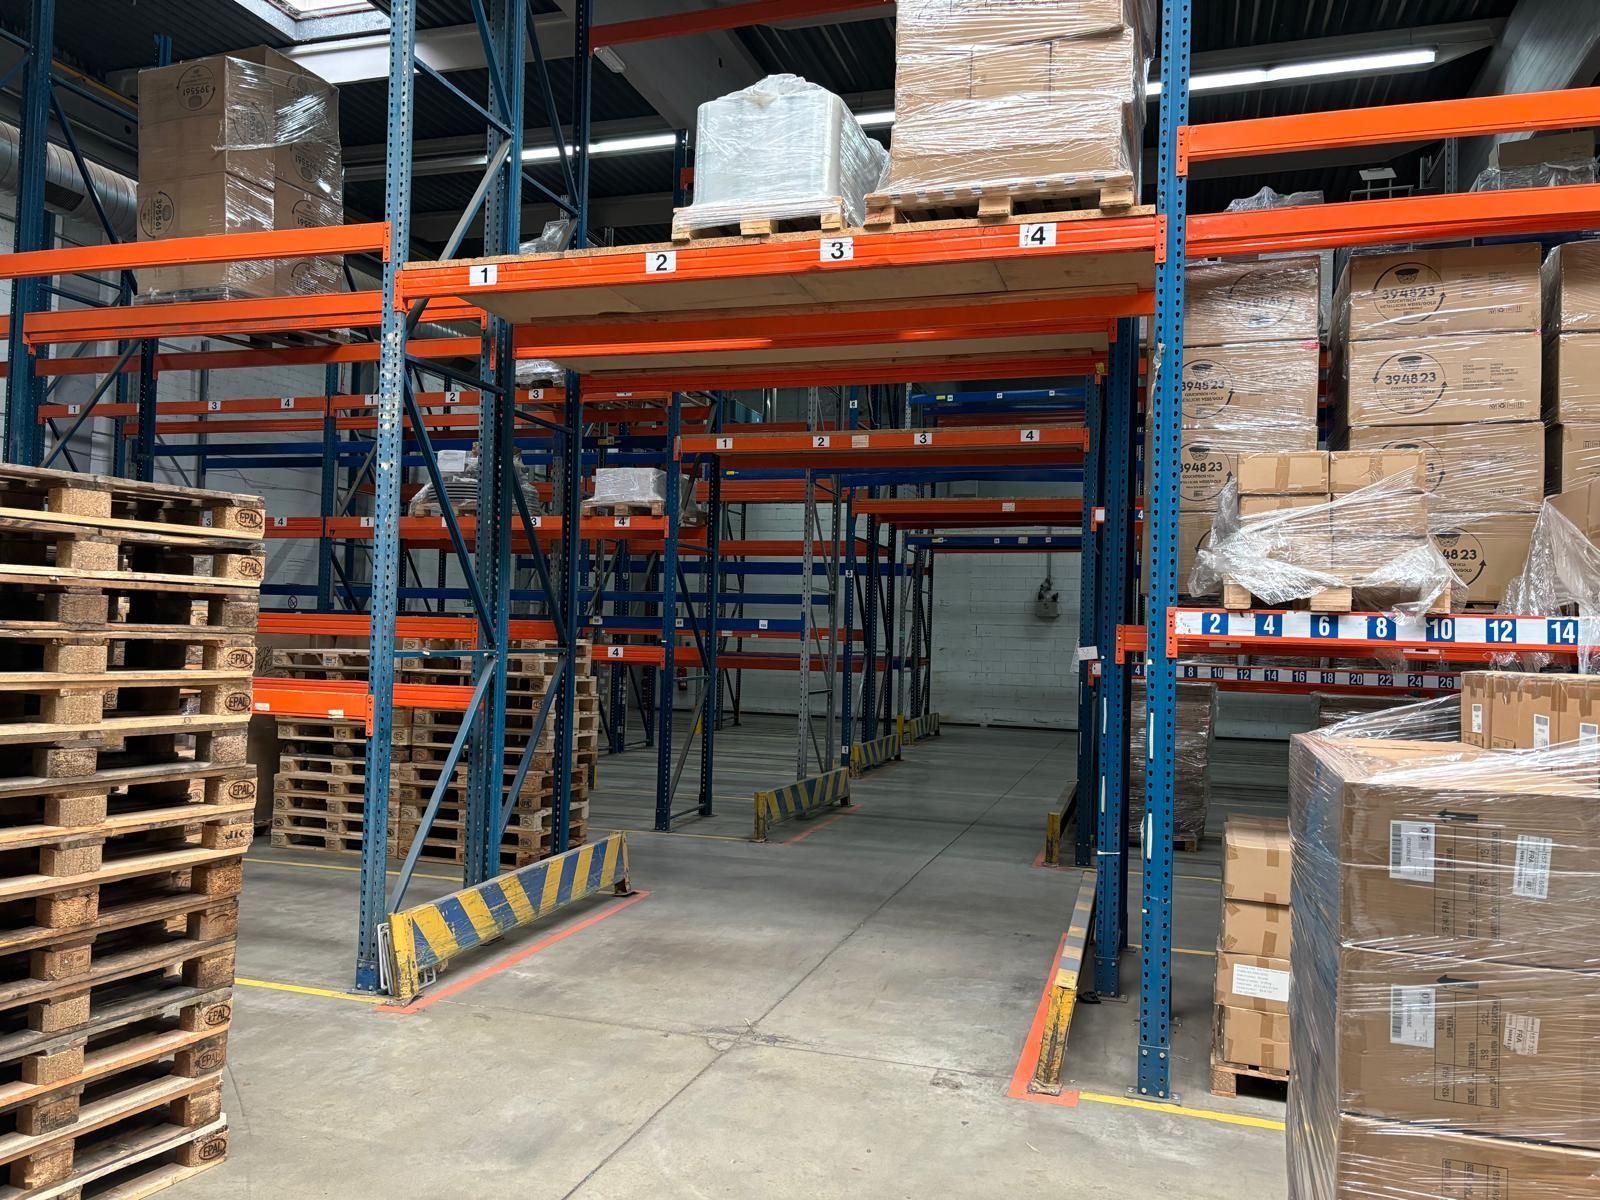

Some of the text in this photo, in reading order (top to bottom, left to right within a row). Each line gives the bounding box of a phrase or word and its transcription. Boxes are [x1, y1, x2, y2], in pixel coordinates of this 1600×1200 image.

[480, 226, 1046, 283] 1 2 3 4
[1381, 286, 1436, 300] 394823
[1385, 372, 1437, 385] 394823
[449, 392, 456, 402] 2
[532, 389, 540, 399] 3
[211, 401, 218, 410] 3
[283, 399, 291, 407] 4
[817, 437, 825, 447] 2
[919, 433, 927, 444] 3
[1025, 430, 1034, 441] 4
[239, 512, 258, 526] EPAL
[277, 517, 284, 526] 4
[618, 517, 626, 526] 4
[1442, 549, 1477, 560] 4823
[240, 561, 258, 574] EPAL
[1209, 613, 1576, 644] 2 4 6 8 10 12 14
[230, 653, 250, 665] EPAL
[612, 648, 619, 657] 4
[1134, 666, 1453, 689] 4 8 10 12 14 16 18 20 22 24 26
[228, 696, 248, 708] EPAL
[232, 784, 252, 796] EPAL
[1421, 827, 1430, 841] 10
[203, 1141, 223, 1158] EPAL
